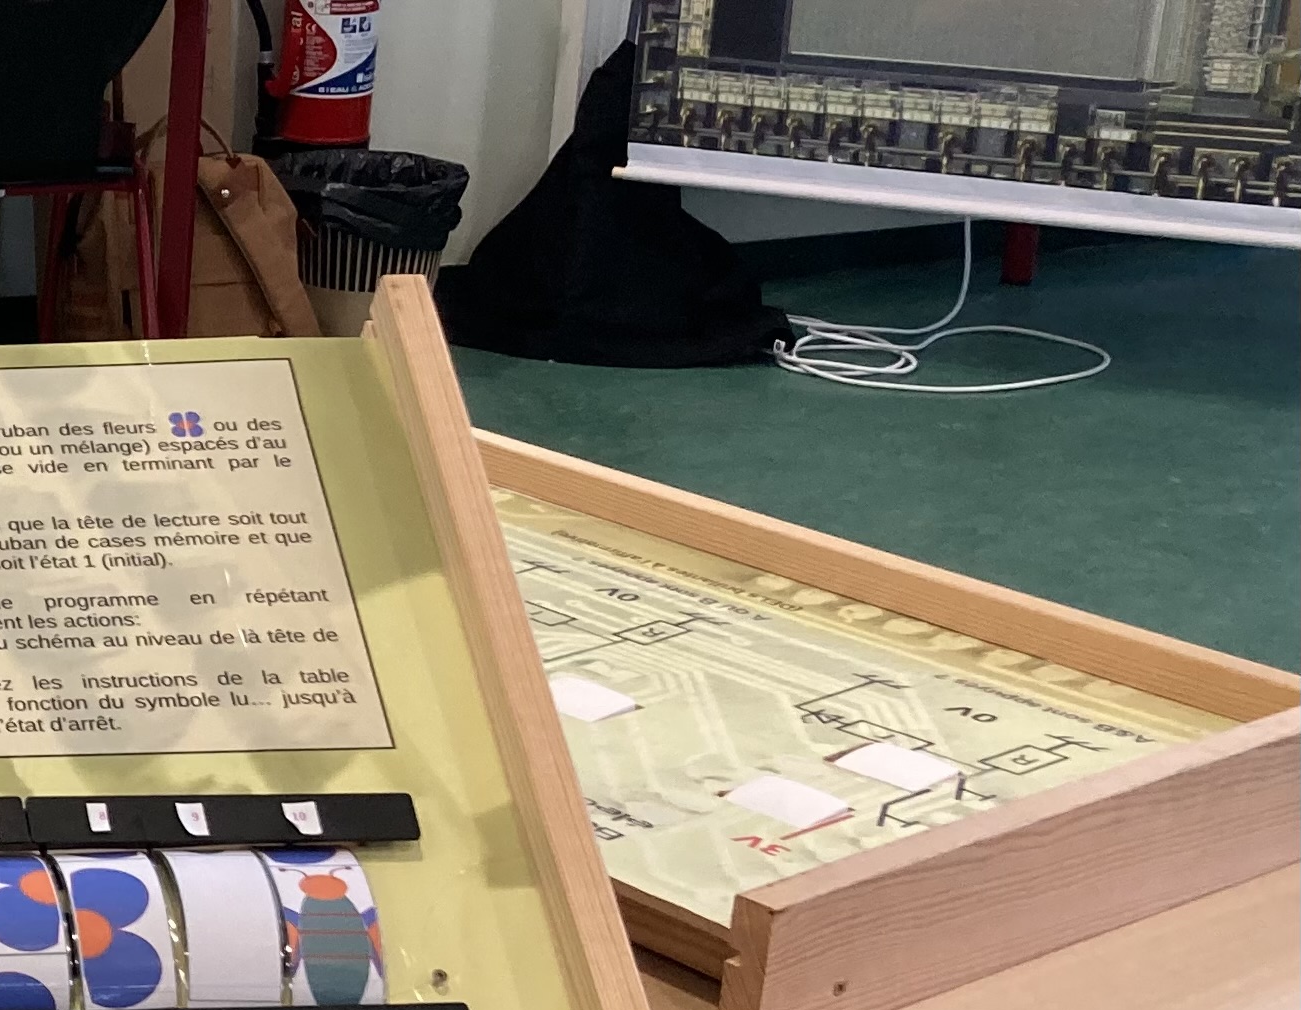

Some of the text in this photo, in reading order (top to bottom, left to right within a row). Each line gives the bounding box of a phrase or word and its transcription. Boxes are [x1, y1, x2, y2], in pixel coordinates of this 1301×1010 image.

[58, 422, 94, 437] des
[103, 420, 156, 436] fleurs
[213, 419, 238, 432] ou
[247, 416, 282, 432] des
[30, 444, 54, 457] un
[158, 436, 238, 454] espacés
[28, 458, 68, 474] vide
[84, 460, 108, 472] en
[122, 454, 214, 471] terminant
[228, 456, 258, 472] par
[273, 453, 291, 468] le
[8, 518, 44, 535] que
[52, 515, 70, 530] la
[78, 513, 114, 529] tête
[122, 512, 146, 528] de
[154, 511, 220, 527] lecture
[228, 510, 262, 525] soit
[270, 509, 306, 524] tout
[55, 534, 80, 548] de
[88, 533, 146, 547] cases
[154, 529, 239, 545] mémoire
[248, 530, 267, 544] et
[275, 529, 312, 546] que
[84, 554, 94, 567] 1
[44, 592, 158, 611] programme
[190, 590, 214, 604] en
[246, 587, 328, 606] répétant
[28, 613, 58, 628] les
[16, 632, 95, 649] schéma
[104, 633, 128, 647] au
[136, 631, 202, 646] niveau
[210, 628, 235, 644] de
[268, 626, 304, 643] tête
[313, 626, 338, 642] de
[33, 674, 62, 690] les
[82, 672, 198, 689] instructions
[218, 670, 242, 686] de
[262, 669, 280, 684] la
[300, 668, 348, 684] table
[7, 694, 88, 712] fonction
[98, 693, 124, 710] du
[136, 690, 220, 710] symbole
[1011, 755, 1039, 765] R
